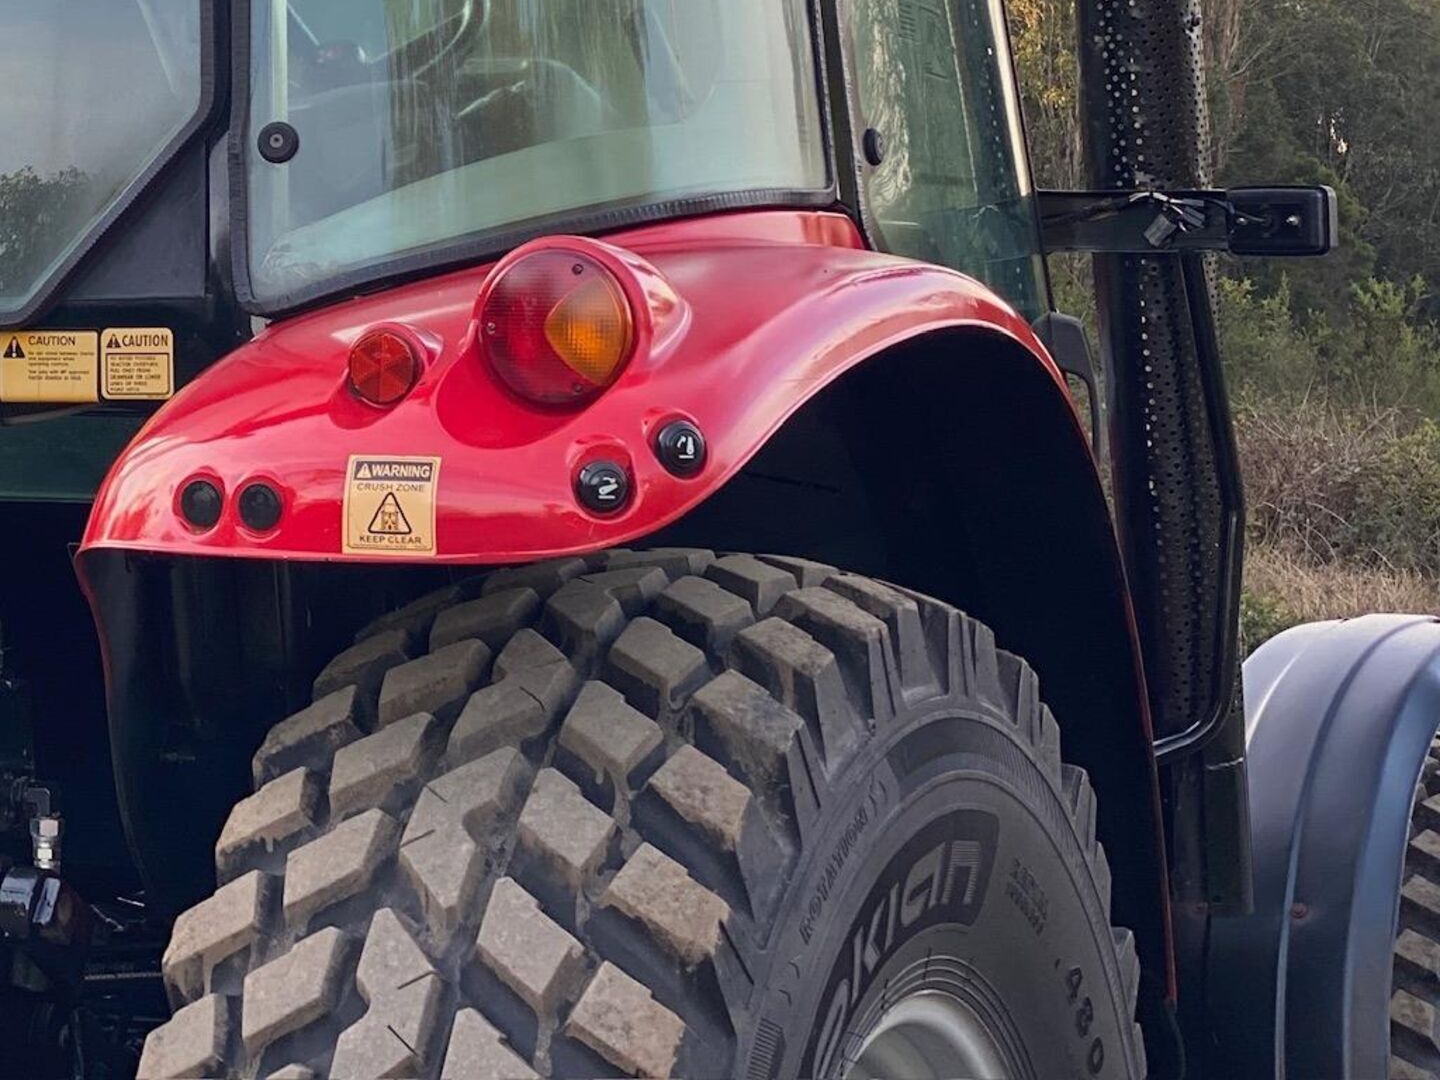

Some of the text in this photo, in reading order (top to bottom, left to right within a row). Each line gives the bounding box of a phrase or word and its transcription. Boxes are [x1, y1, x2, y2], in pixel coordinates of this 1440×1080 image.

[28, 335, 76, 346] CAUTION
[122, 334, 169, 347] CAUTION
[371, 463, 430, 478] WARNING
[356, 482, 425, 493] CRUSH ZONE
[359, 535, 422, 545] KEEP CLEAR
